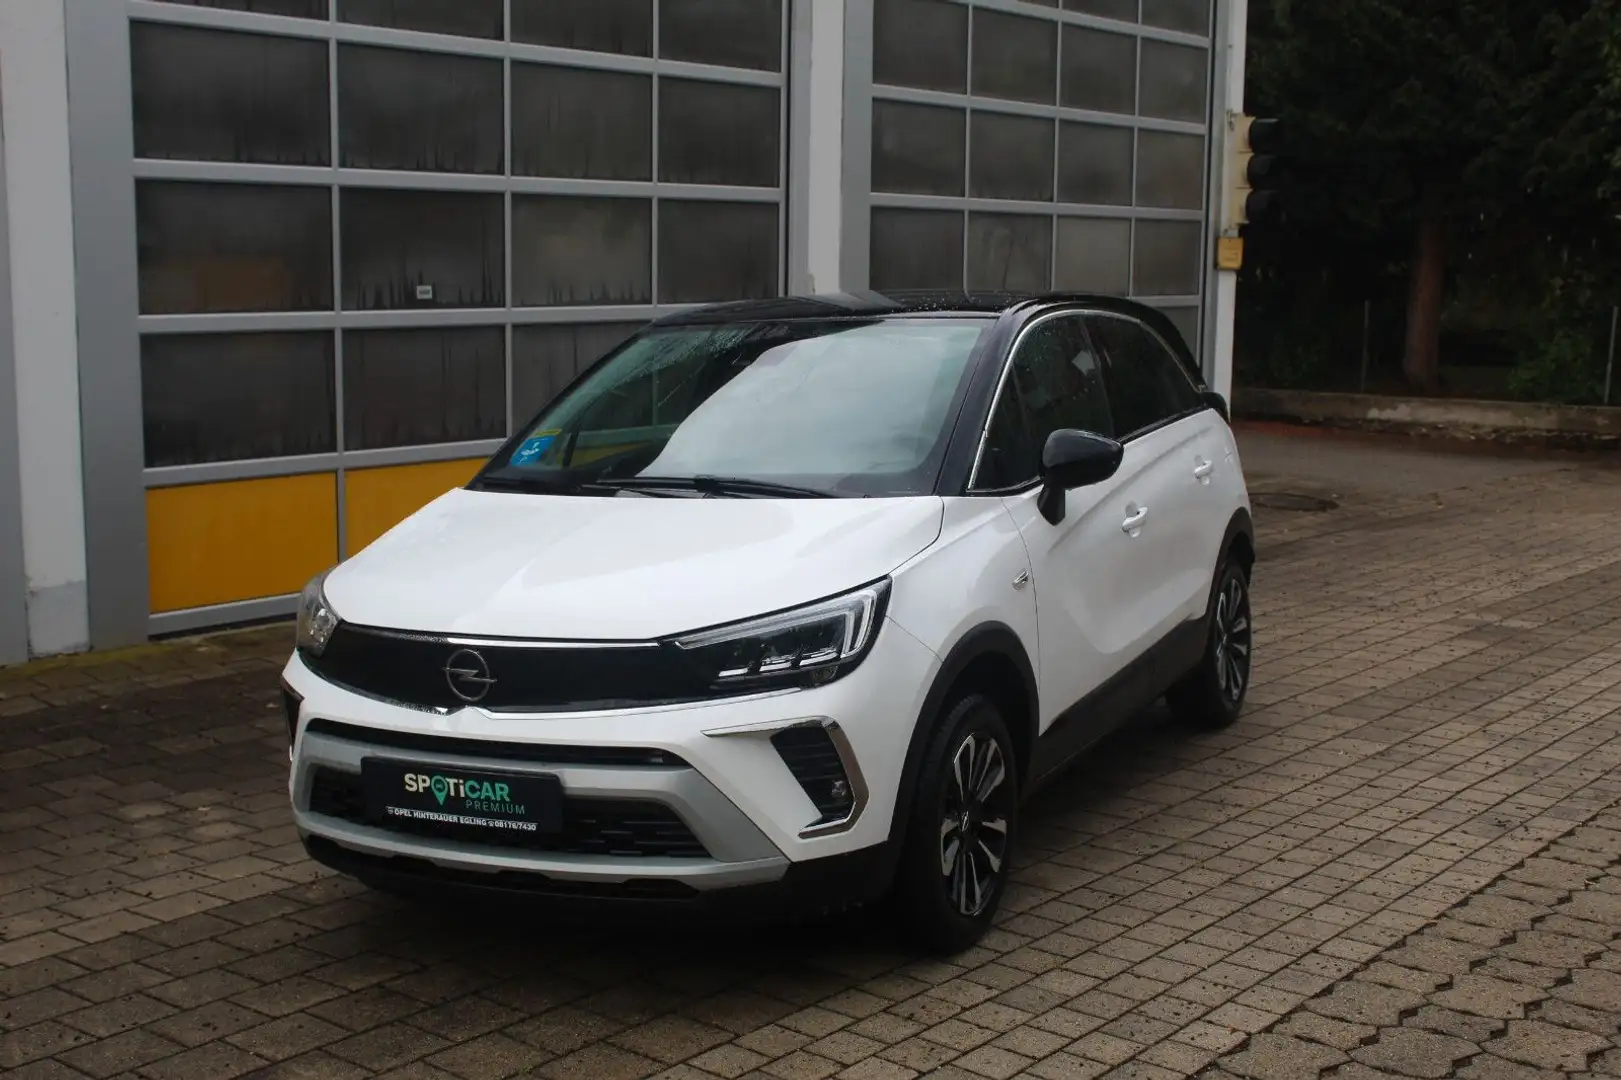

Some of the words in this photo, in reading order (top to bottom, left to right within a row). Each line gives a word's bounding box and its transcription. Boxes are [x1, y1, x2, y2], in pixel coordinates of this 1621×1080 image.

[466, 799, 525, 815] PREMIUM
[394, 808, 412, 817] OPEL
[413, 811, 458, 823] HINTERAUER
[460, 816, 487, 826] EGLING
